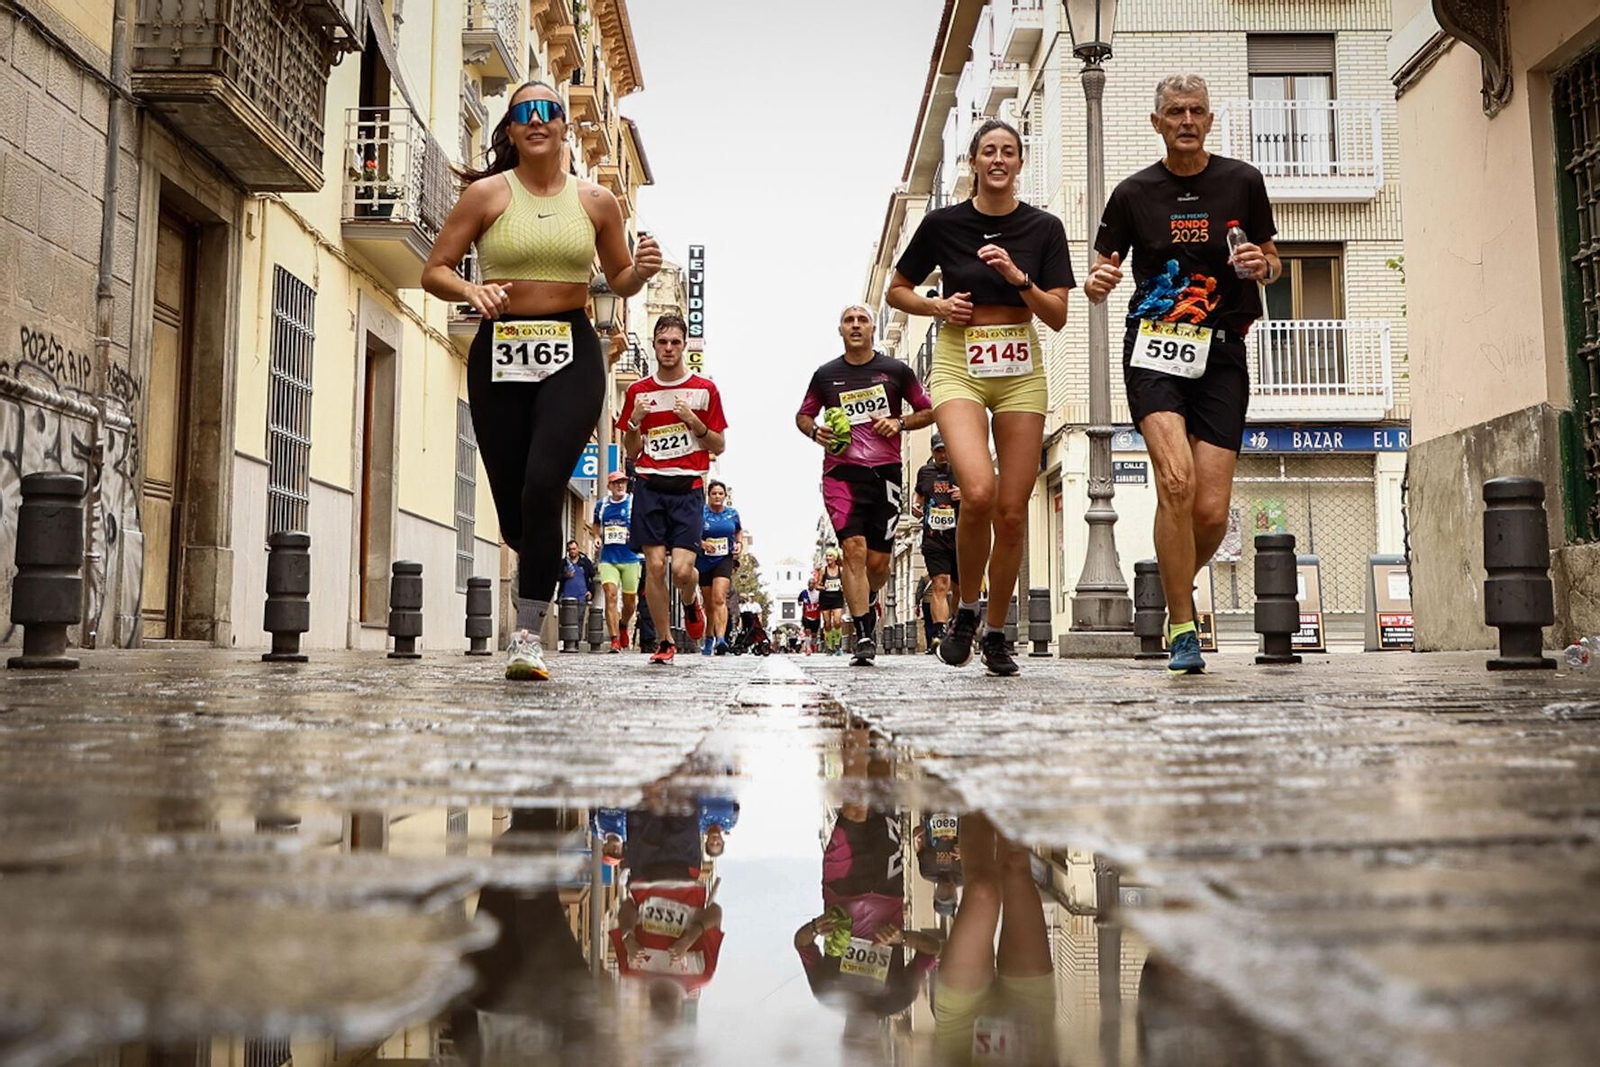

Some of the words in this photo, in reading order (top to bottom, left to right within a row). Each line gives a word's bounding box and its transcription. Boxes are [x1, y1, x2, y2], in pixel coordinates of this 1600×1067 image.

[1171, 219, 1209, 229] FONDO
[1171, 229, 1209, 243] 2025
[690, 246, 703, 336] TEJIDOS
[496, 343, 569, 366] 3165
[969, 343, 1029, 364] 2145
[1146, 339, 1196, 363] 596
[844, 397, 887, 417] 3092
[650, 434, 689, 452] 3221
[1293, 432, 1343, 448] BAZAR
[1374, 432, 1392, 447] EL
[931, 516, 954, 525] 1069
